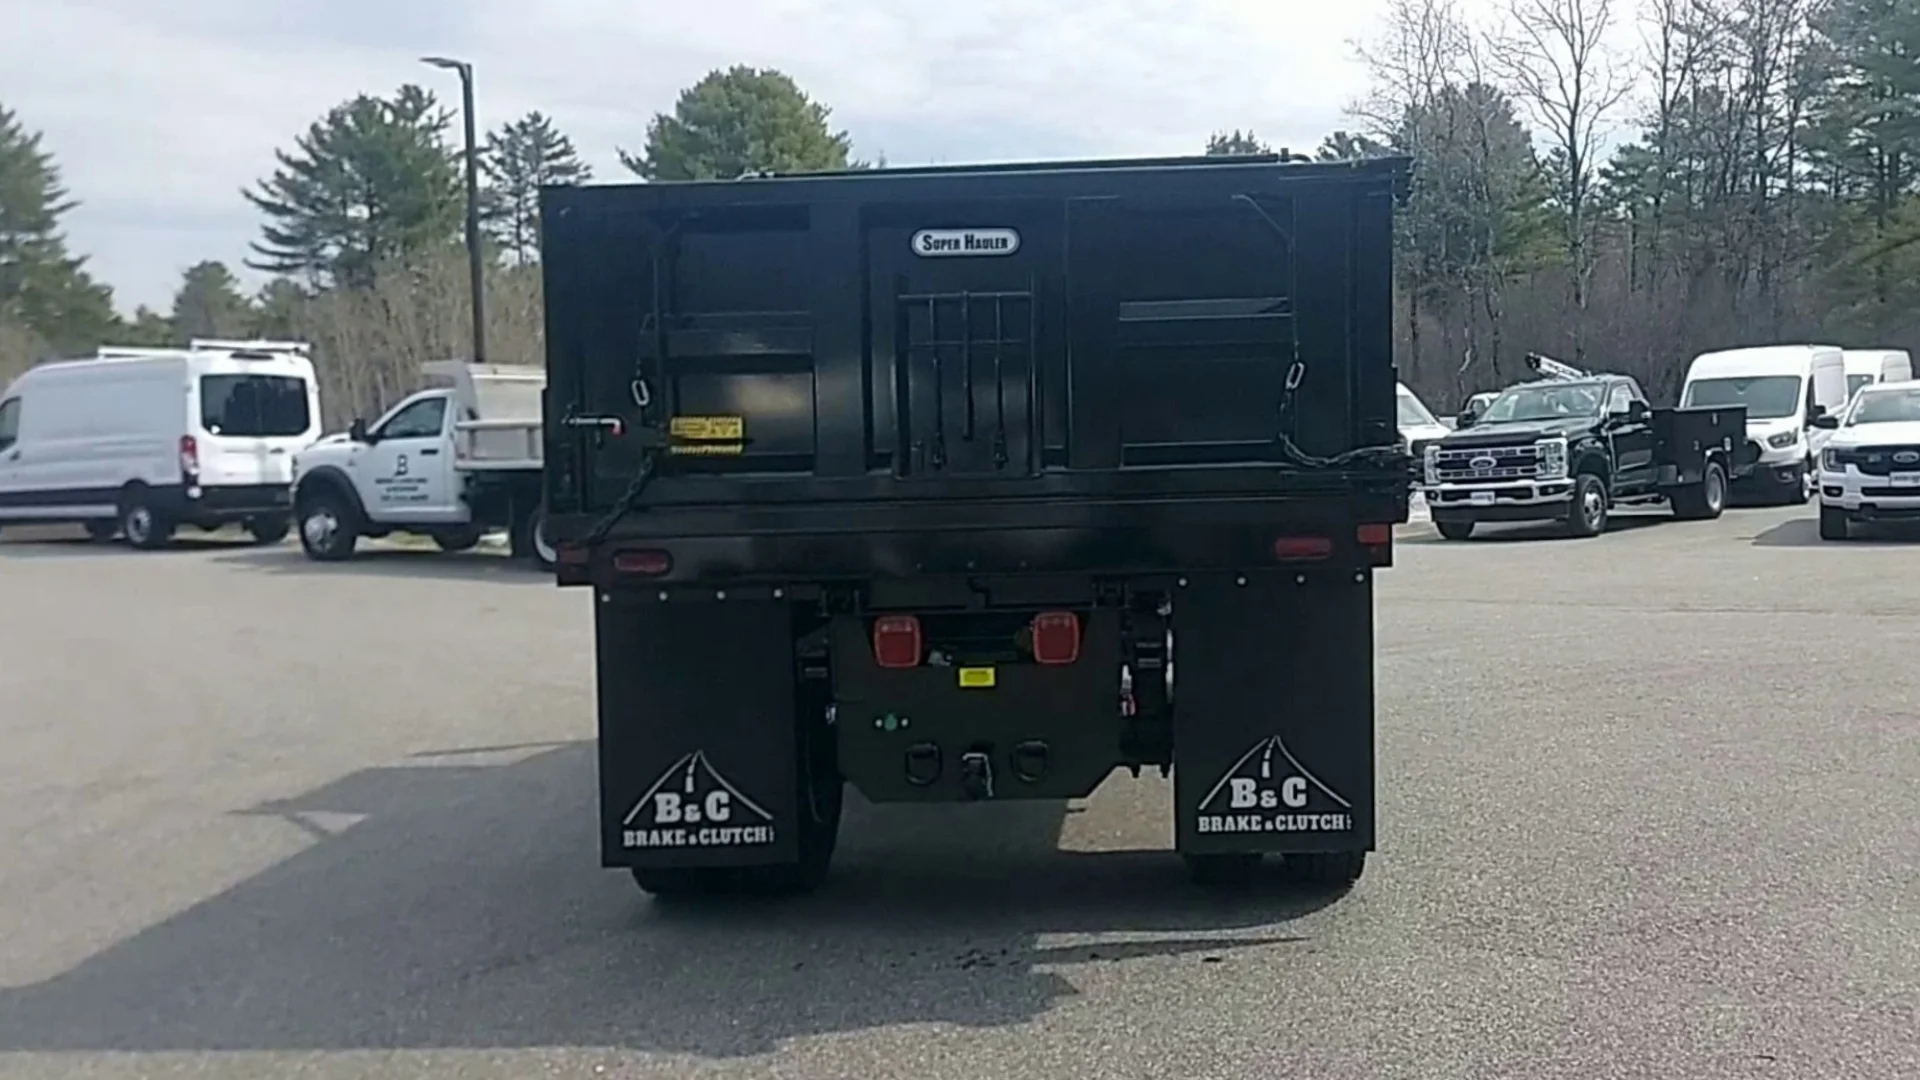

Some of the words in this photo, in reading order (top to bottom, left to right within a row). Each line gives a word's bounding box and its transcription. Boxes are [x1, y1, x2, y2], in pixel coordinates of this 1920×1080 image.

[1198, 815, 1262, 832] BRAKE
[1275, 814, 1345, 831] CLUTCH
[623, 829, 687, 847] BRAKE
[699, 826, 767, 845] CLUTCH
